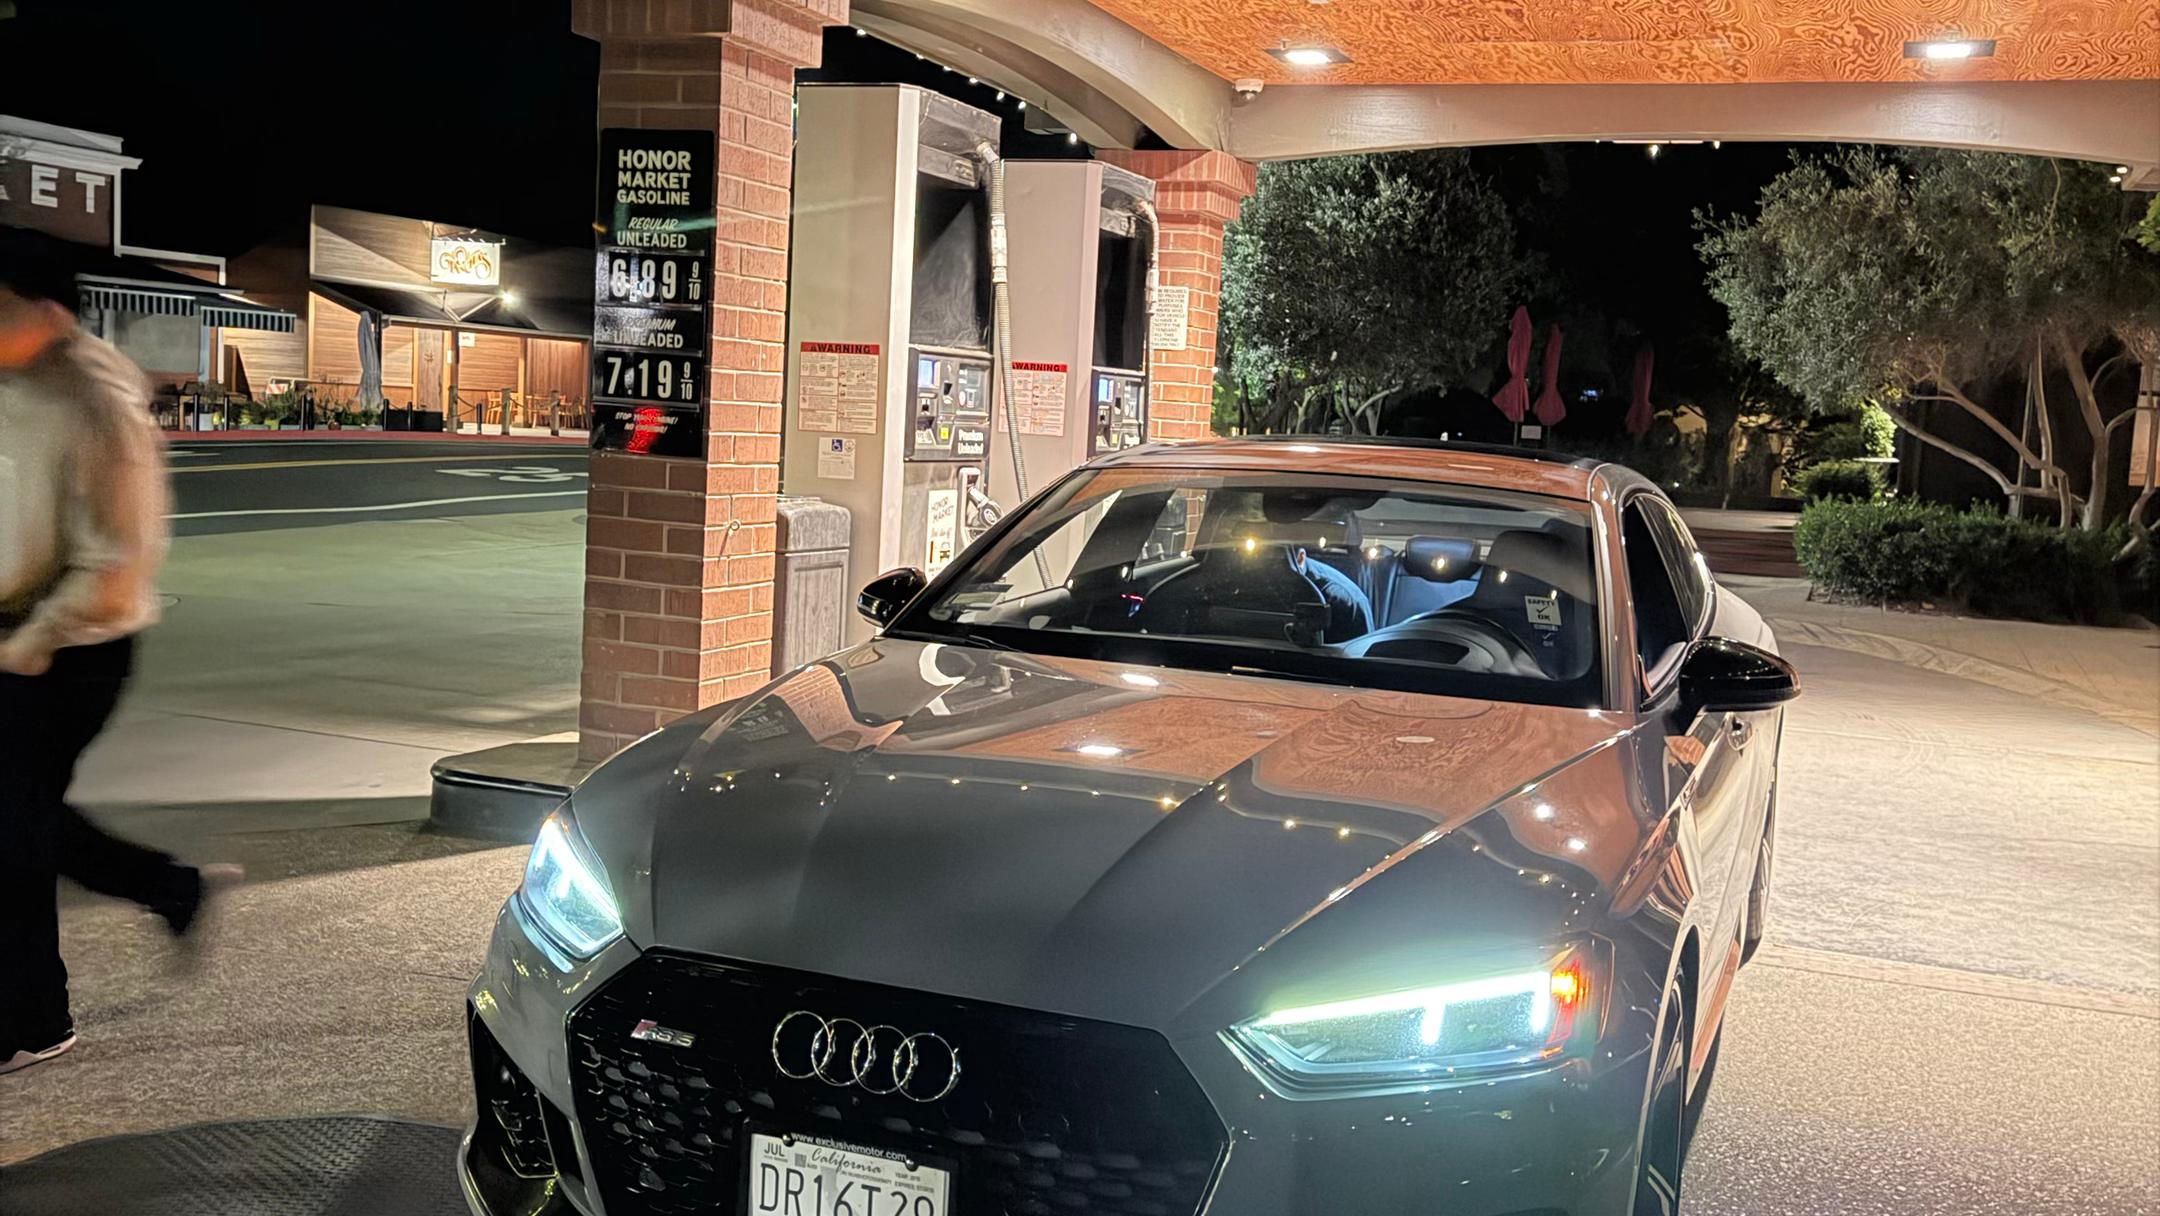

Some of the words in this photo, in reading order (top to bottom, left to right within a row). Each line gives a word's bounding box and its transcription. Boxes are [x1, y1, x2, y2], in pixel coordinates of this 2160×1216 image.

[618, 149, 691, 170] HONOR
[0, 159, 106, 213] ET
[617, 171, 691, 189] MARKET
[616, 189, 690, 205] GASOLINE
[628, 216, 679, 230] REGULAR
[616, 231, 687, 248] UNLEADED
[614, 330, 684, 348] UNLEADED
[816, 343, 871, 354] WARNING
[1014, 362, 1061, 372] WARNING
[764, 1141, 785, 1157] JUL
[811, 1147, 882, 1173] California
